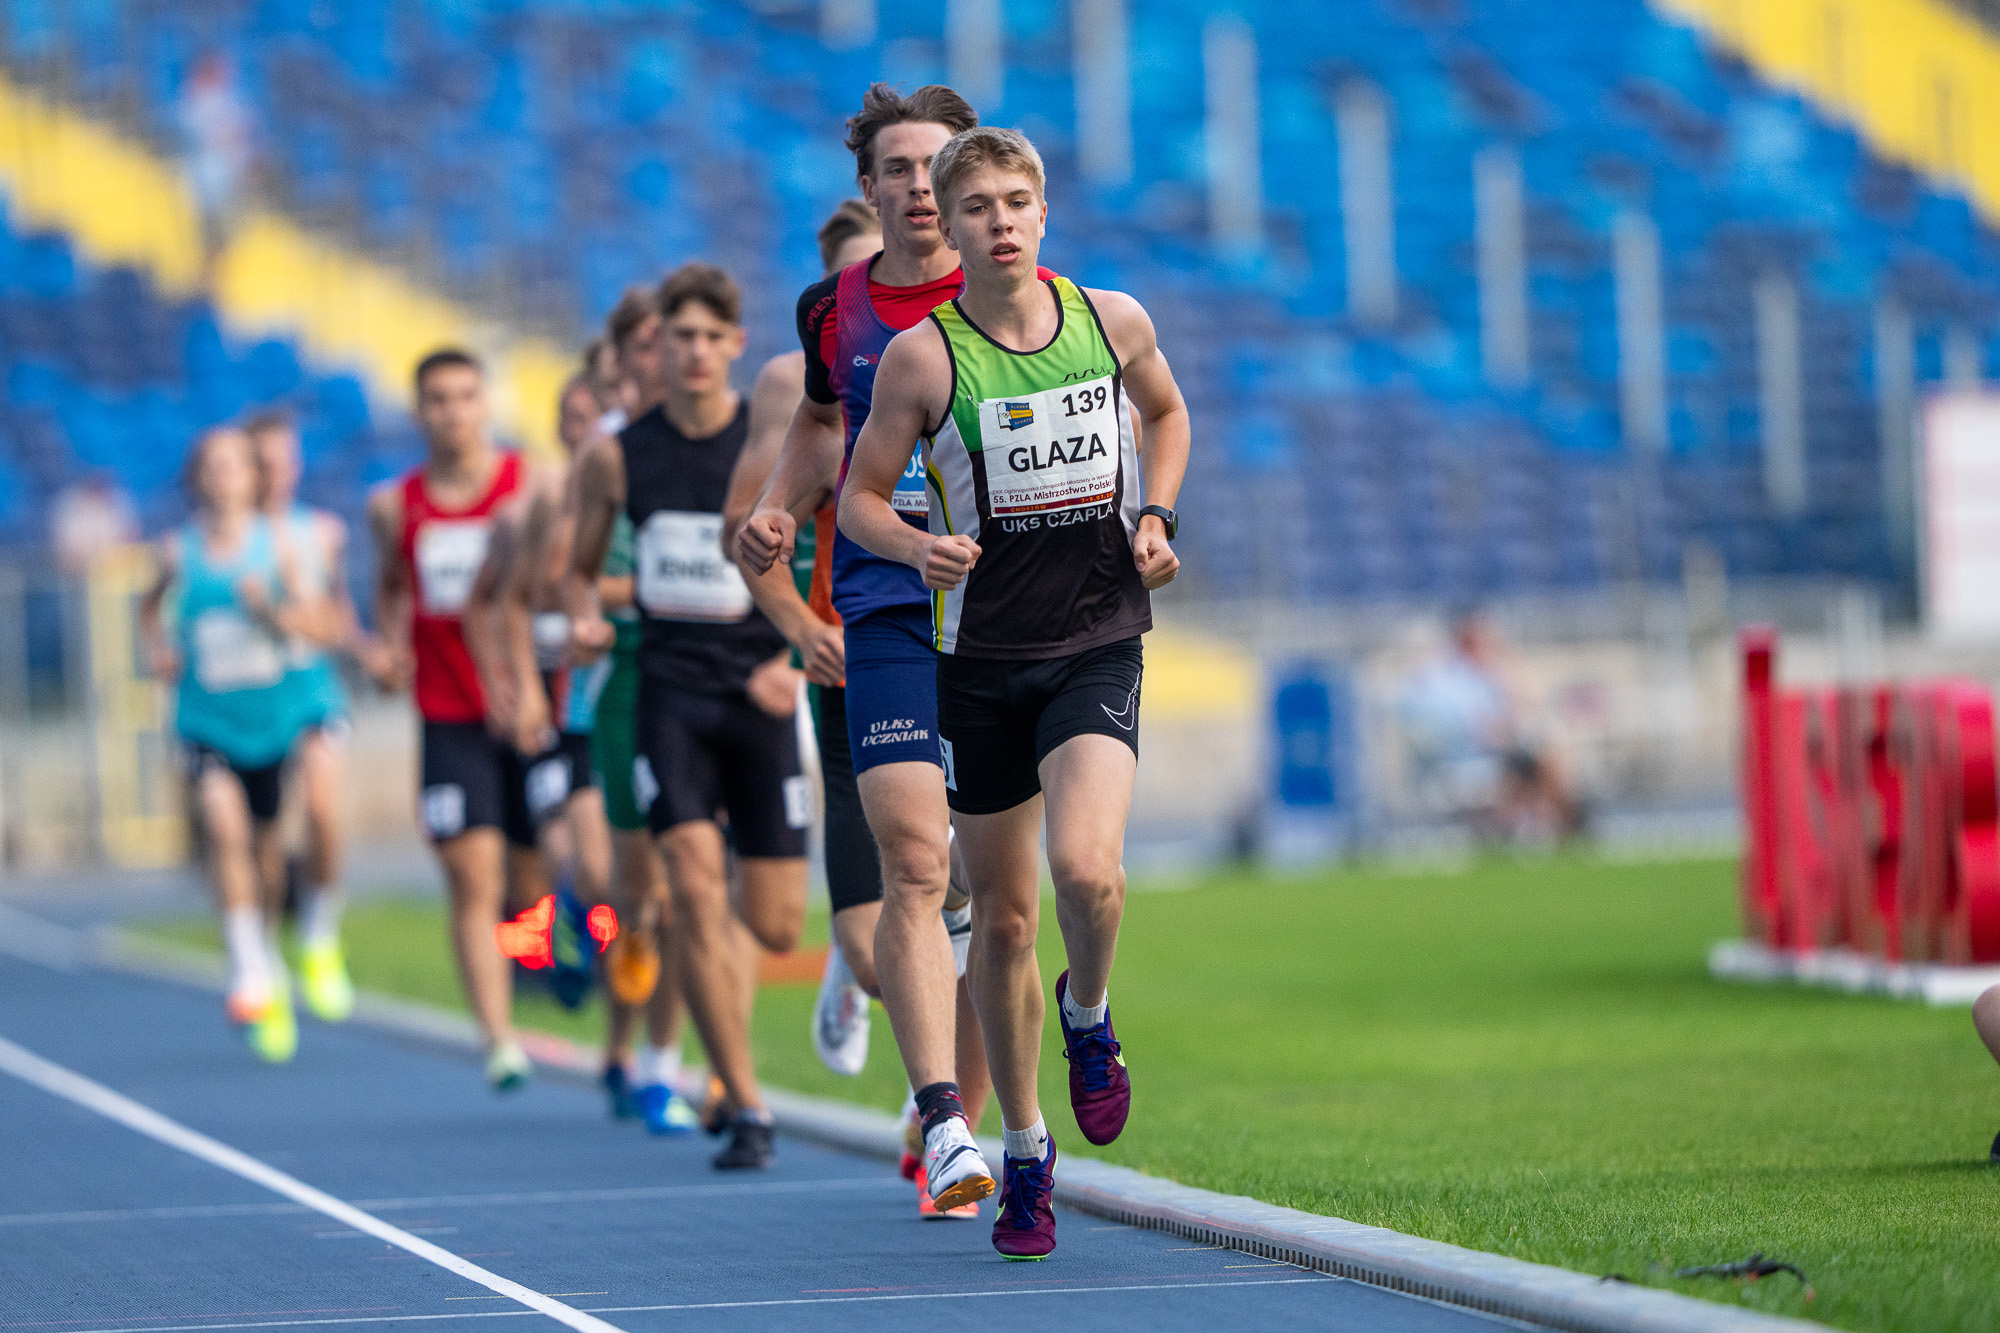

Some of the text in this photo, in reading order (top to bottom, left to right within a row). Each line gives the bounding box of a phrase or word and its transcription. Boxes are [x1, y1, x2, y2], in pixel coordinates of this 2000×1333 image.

[1061, 386, 1107, 417] 139
[1008, 433, 1108, 472] GLAZA
[893, 499, 912, 507] PZLA
[993, 495, 1007, 503] 55.
[1009, 494, 1031, 503] PZLA
[1034, 486, 1086, 500] Mistrzostwa
[1088, 478, 1112, 491] Polski
[1002, 503, 1114, 533] UKS CZAPLA
